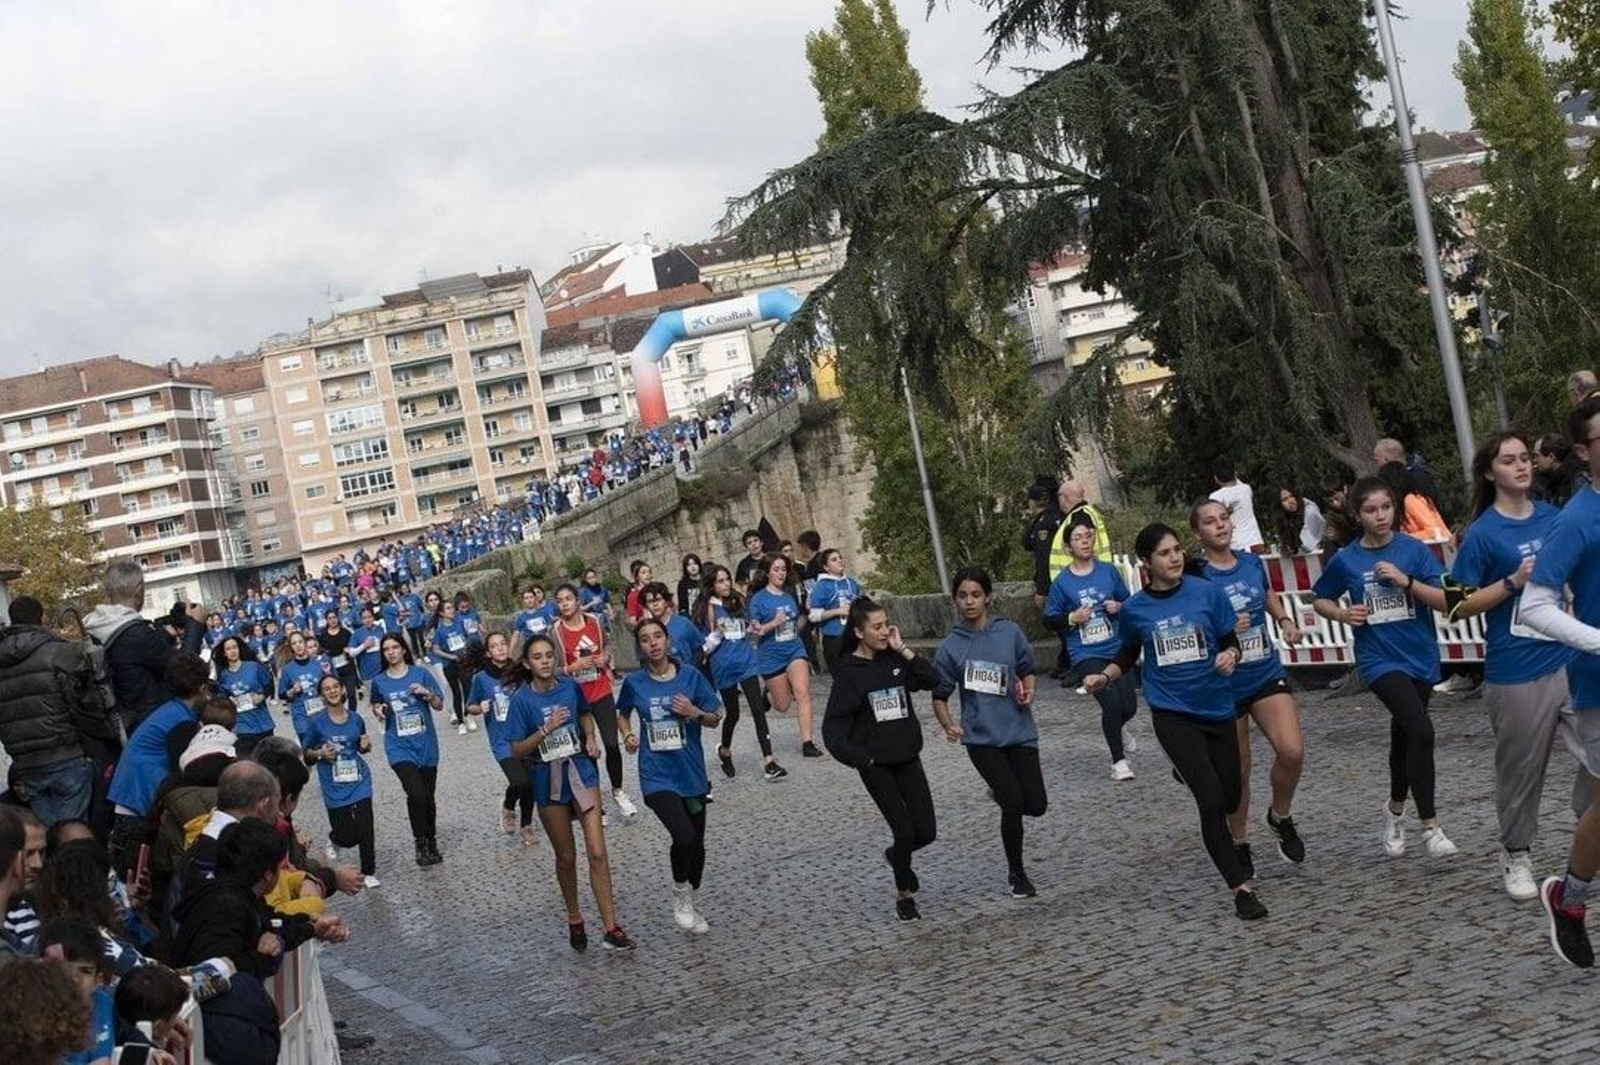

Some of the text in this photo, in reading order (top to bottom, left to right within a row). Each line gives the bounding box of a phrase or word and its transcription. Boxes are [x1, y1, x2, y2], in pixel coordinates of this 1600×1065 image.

[706, 308, 753, 324] CaixaBank
[1374, 595, 1404, 611] 11958
[1165, 635, 1196, 653] 11956
[974, 669, 999, 684] 11045
[875, 697, 898, 712] 11063
[547, 734, 570, 751] 11646
[655, 728, 679, 742] 11644
